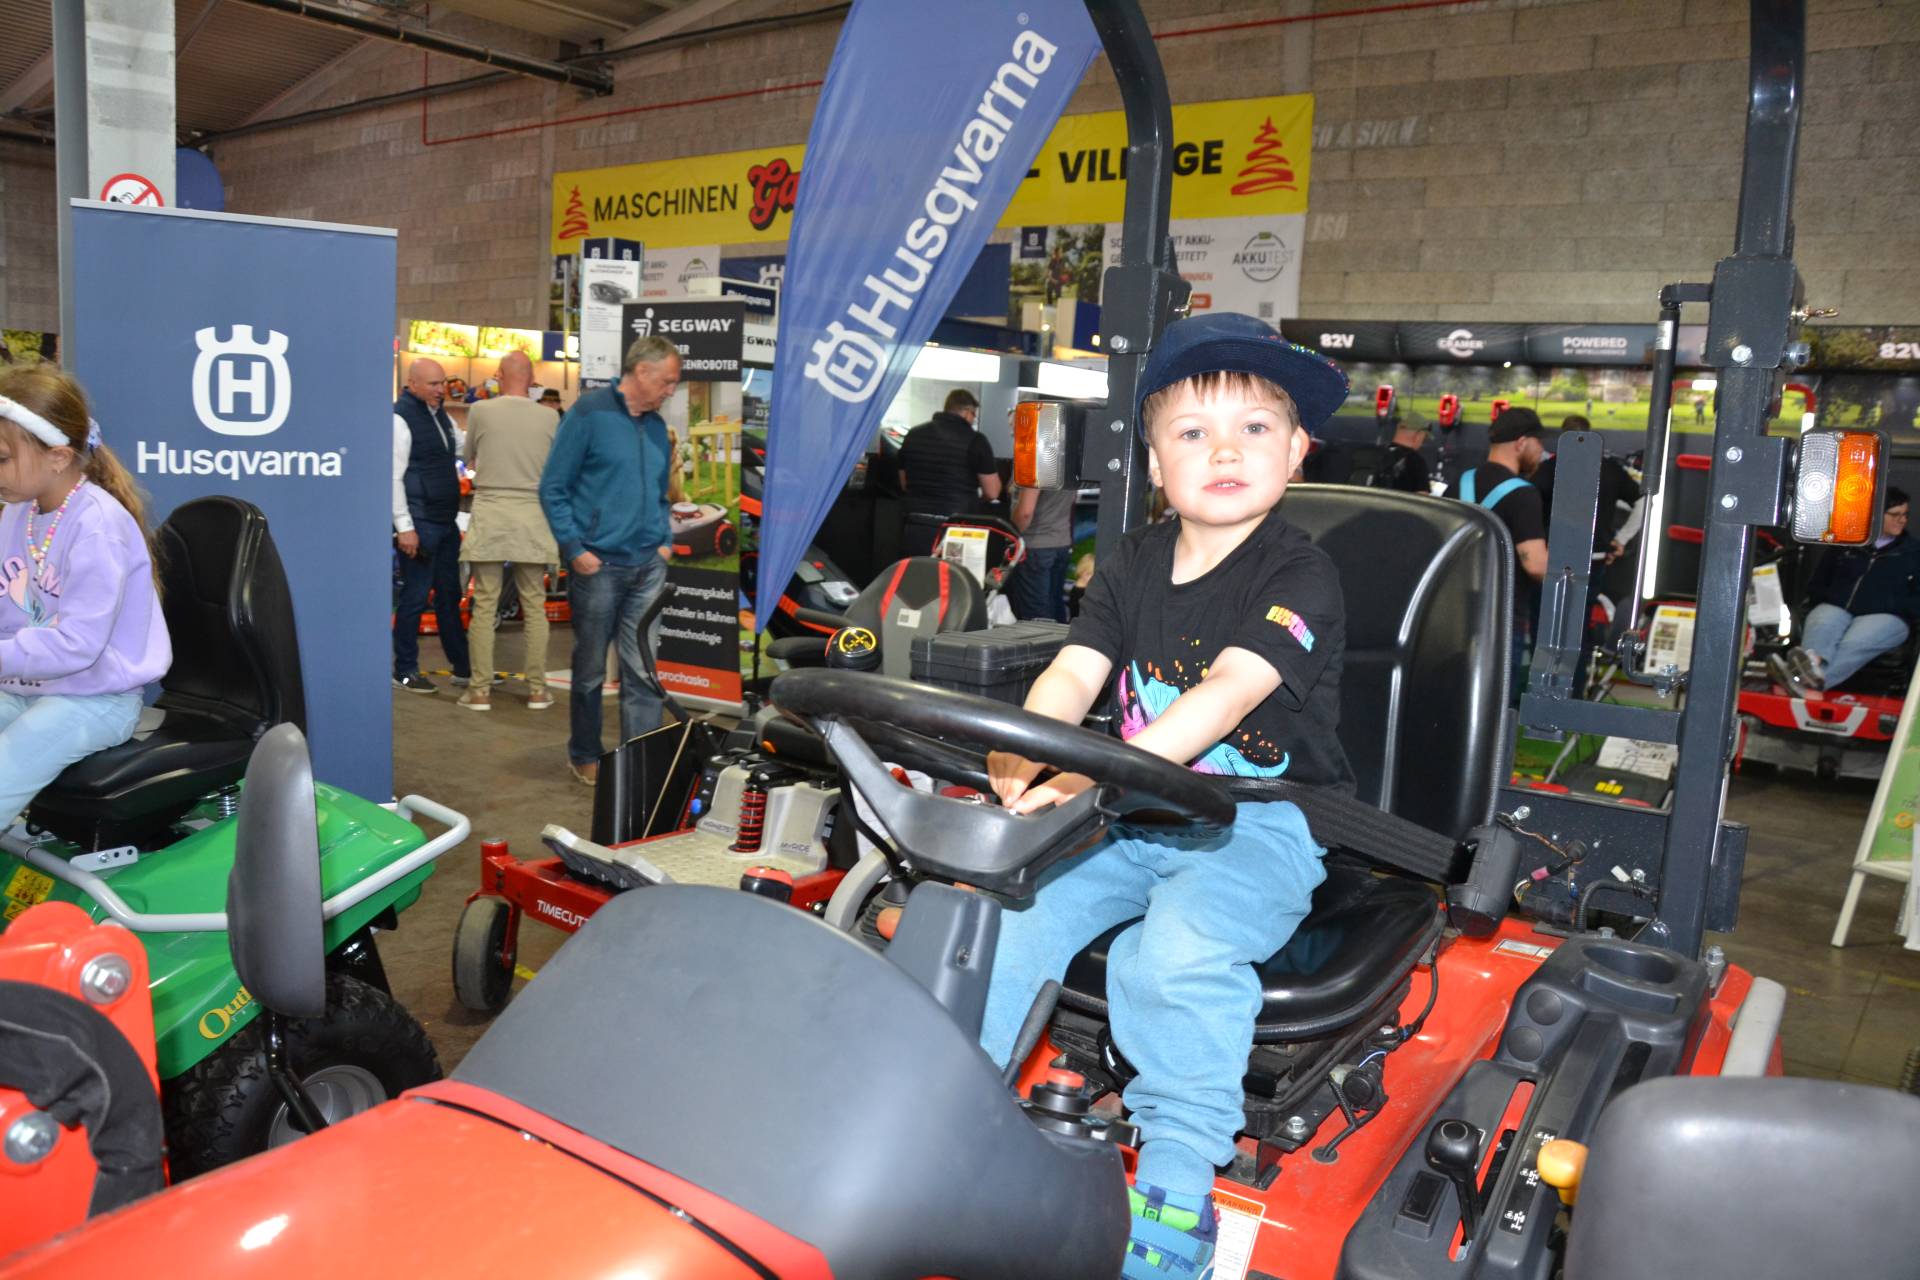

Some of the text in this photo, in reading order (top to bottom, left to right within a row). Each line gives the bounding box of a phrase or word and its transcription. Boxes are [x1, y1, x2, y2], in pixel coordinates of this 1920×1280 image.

[594, 159, 800, 230] MASCHINEN Ga
[847, 30, 1058, 339] Husqvarna
[658, 318, 731, 332] SEGWAY
[1320, 333, 1354, 348] 82V
[1563, 336, 1627, 348] POWERED
[137, 441, 342, 480] Husqvarna
[537, 899, 589, 927] TIMECUT
